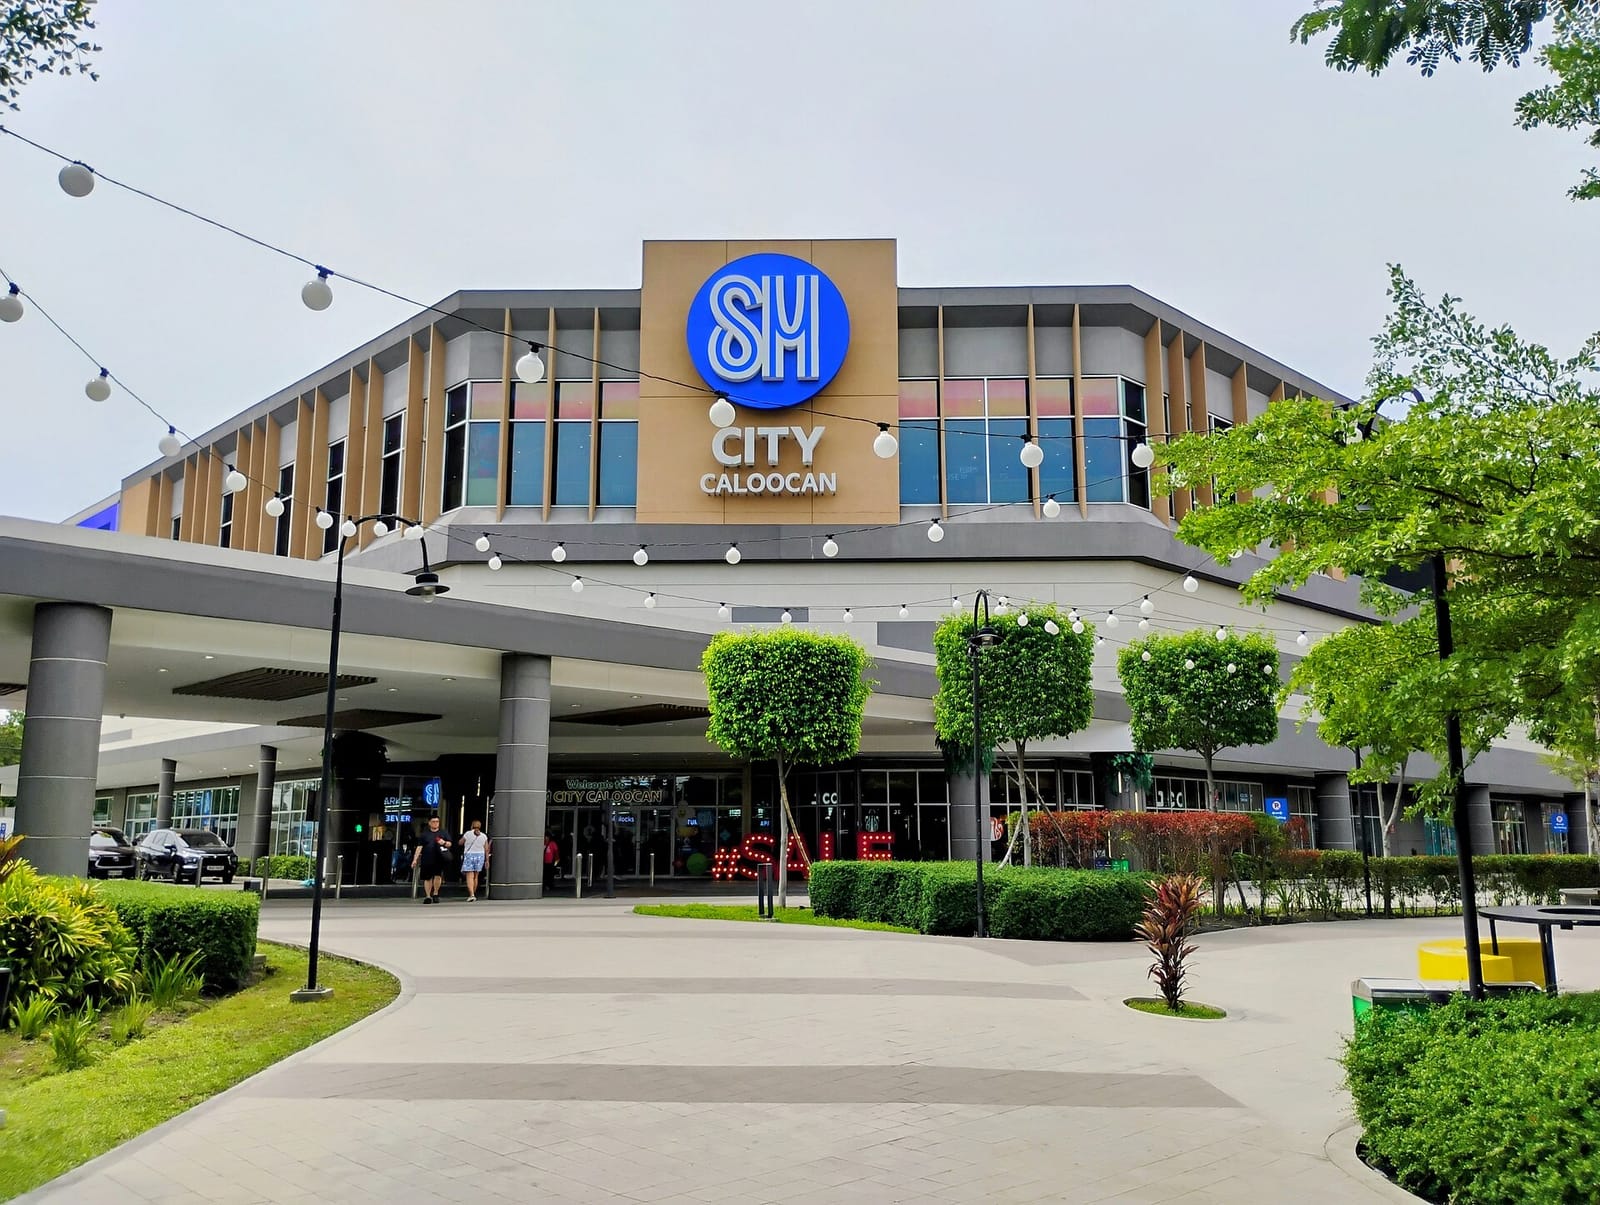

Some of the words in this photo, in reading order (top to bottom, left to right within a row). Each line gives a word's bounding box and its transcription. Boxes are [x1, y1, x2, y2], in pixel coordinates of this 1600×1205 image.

[708, 274, 820, 382] SM
[711, 426, 826, 467] CITY
[699, 472, 837, 496] CALOOCAN
[553, 790, 586, 803] CITY
[586, 790, 663, 803] CALOOCAN
[566, 779, 613, 790] Welcome
[615, 779, 627, 790] to
